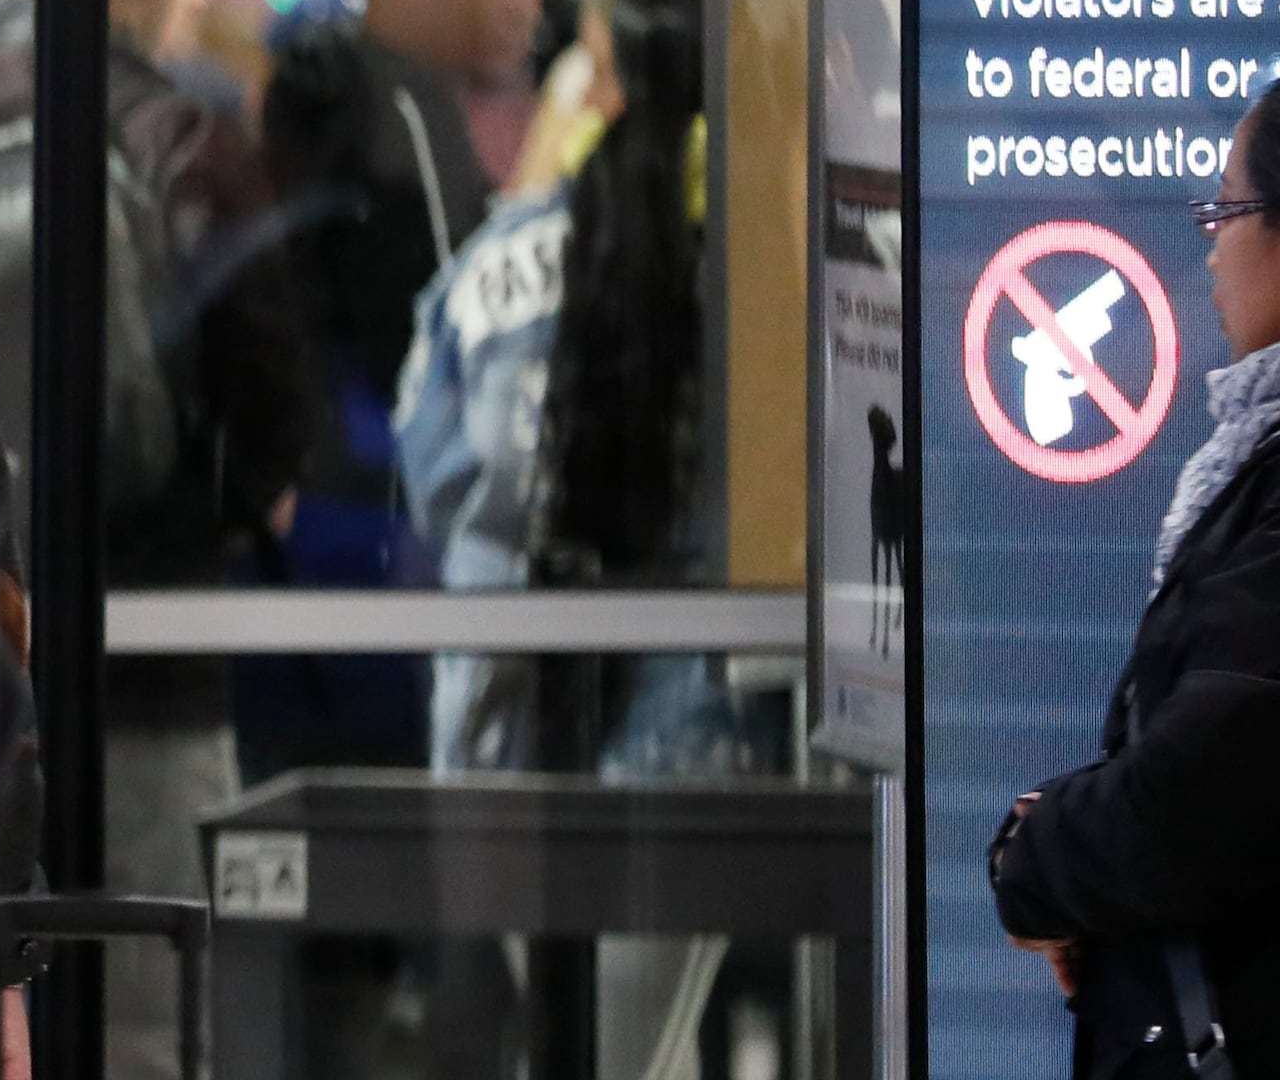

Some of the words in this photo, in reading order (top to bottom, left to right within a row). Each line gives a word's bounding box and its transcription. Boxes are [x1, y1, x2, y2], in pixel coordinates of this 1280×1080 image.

[965, 47, 1014, 98] to
[1028, 46, 1190, 99] federal
[1206, 57, 1258, 99] or
